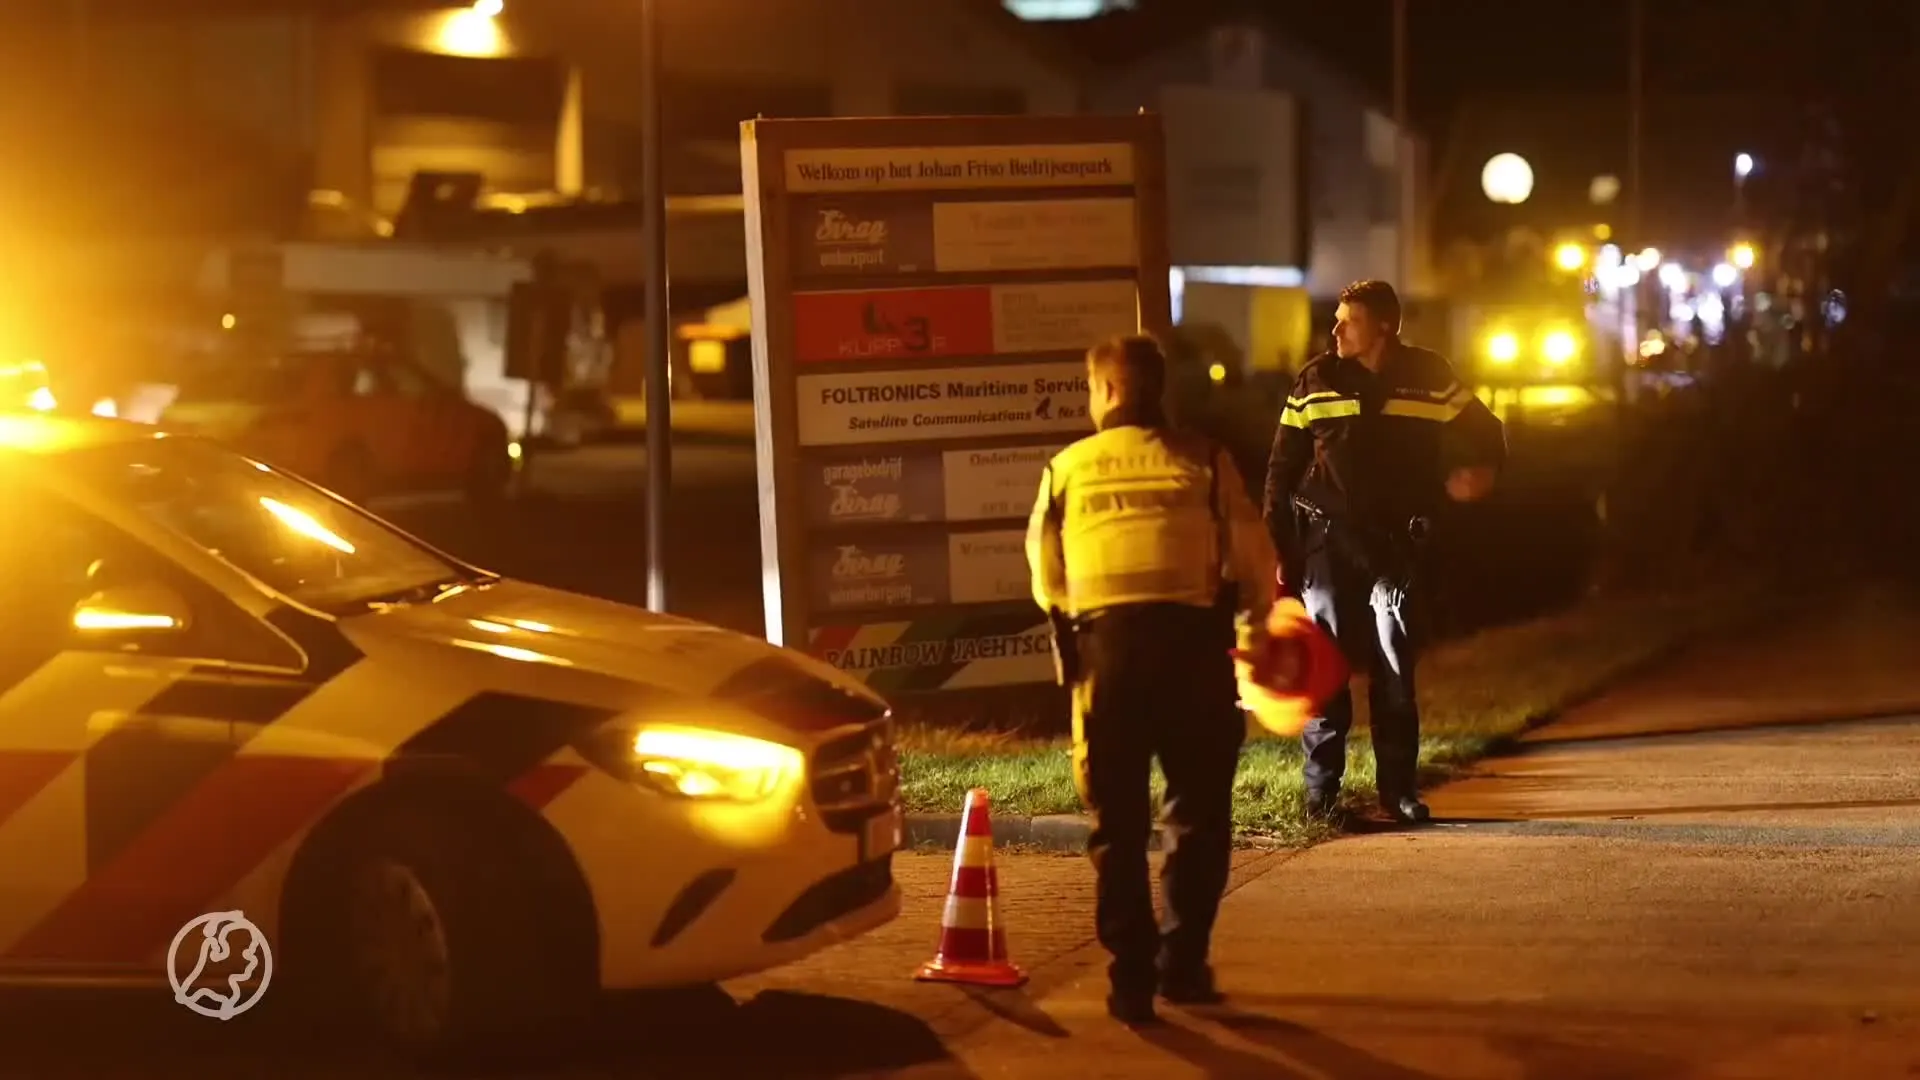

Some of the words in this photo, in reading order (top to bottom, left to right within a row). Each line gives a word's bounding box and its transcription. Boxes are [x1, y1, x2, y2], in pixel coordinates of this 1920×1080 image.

[797, 162, 860, 181] Welkom
[865, 165, 885, 184] op
[889, 160, 912, 178] het
[918, 159, 962, 178] Johan
[967, 160, 1004, 178] Friso
[820, 383, 941, 405] FOLTRONICS
[947, 380, 1029, 402] Maritime
[1034, 376, 1090, 396] Servic
[848, 412, 908, 431] Satellite
[913, 407, 1032, 428] Communications
[823, 456, 902, 486] garagebedrijf
[824, 639, 945, 670] RAINBOW
